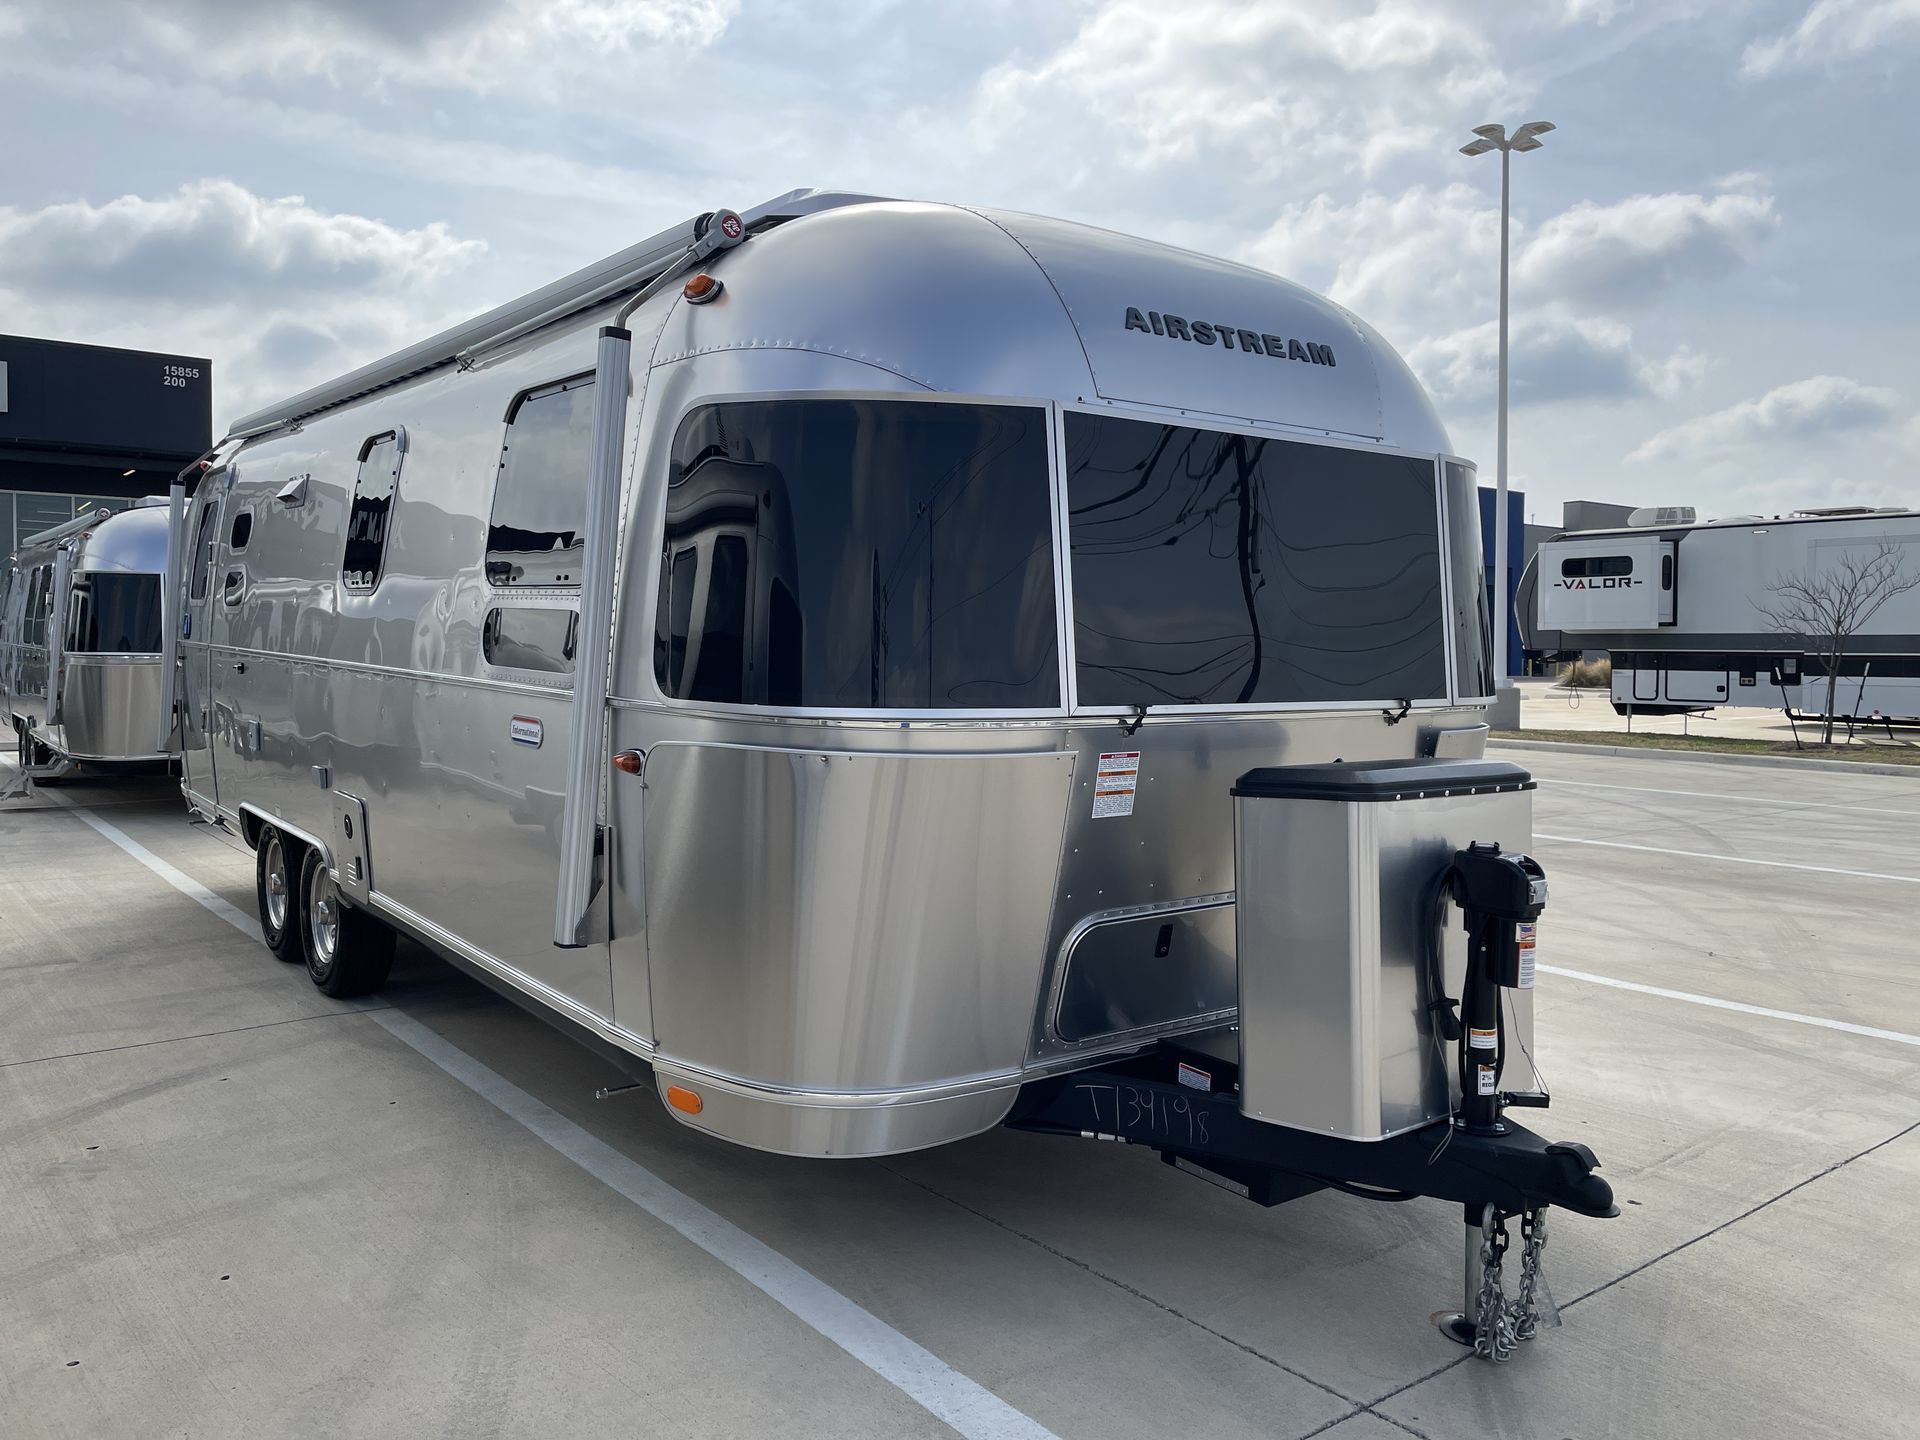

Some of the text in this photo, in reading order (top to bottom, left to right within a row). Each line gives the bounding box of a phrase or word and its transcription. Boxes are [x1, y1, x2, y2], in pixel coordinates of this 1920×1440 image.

[1125, 307, 1336, 367] AIRSTREAM
[163, 365, 200, 379] 15855
[163, 376, 186, 388] 200
[511, 724, 540, 738] International
